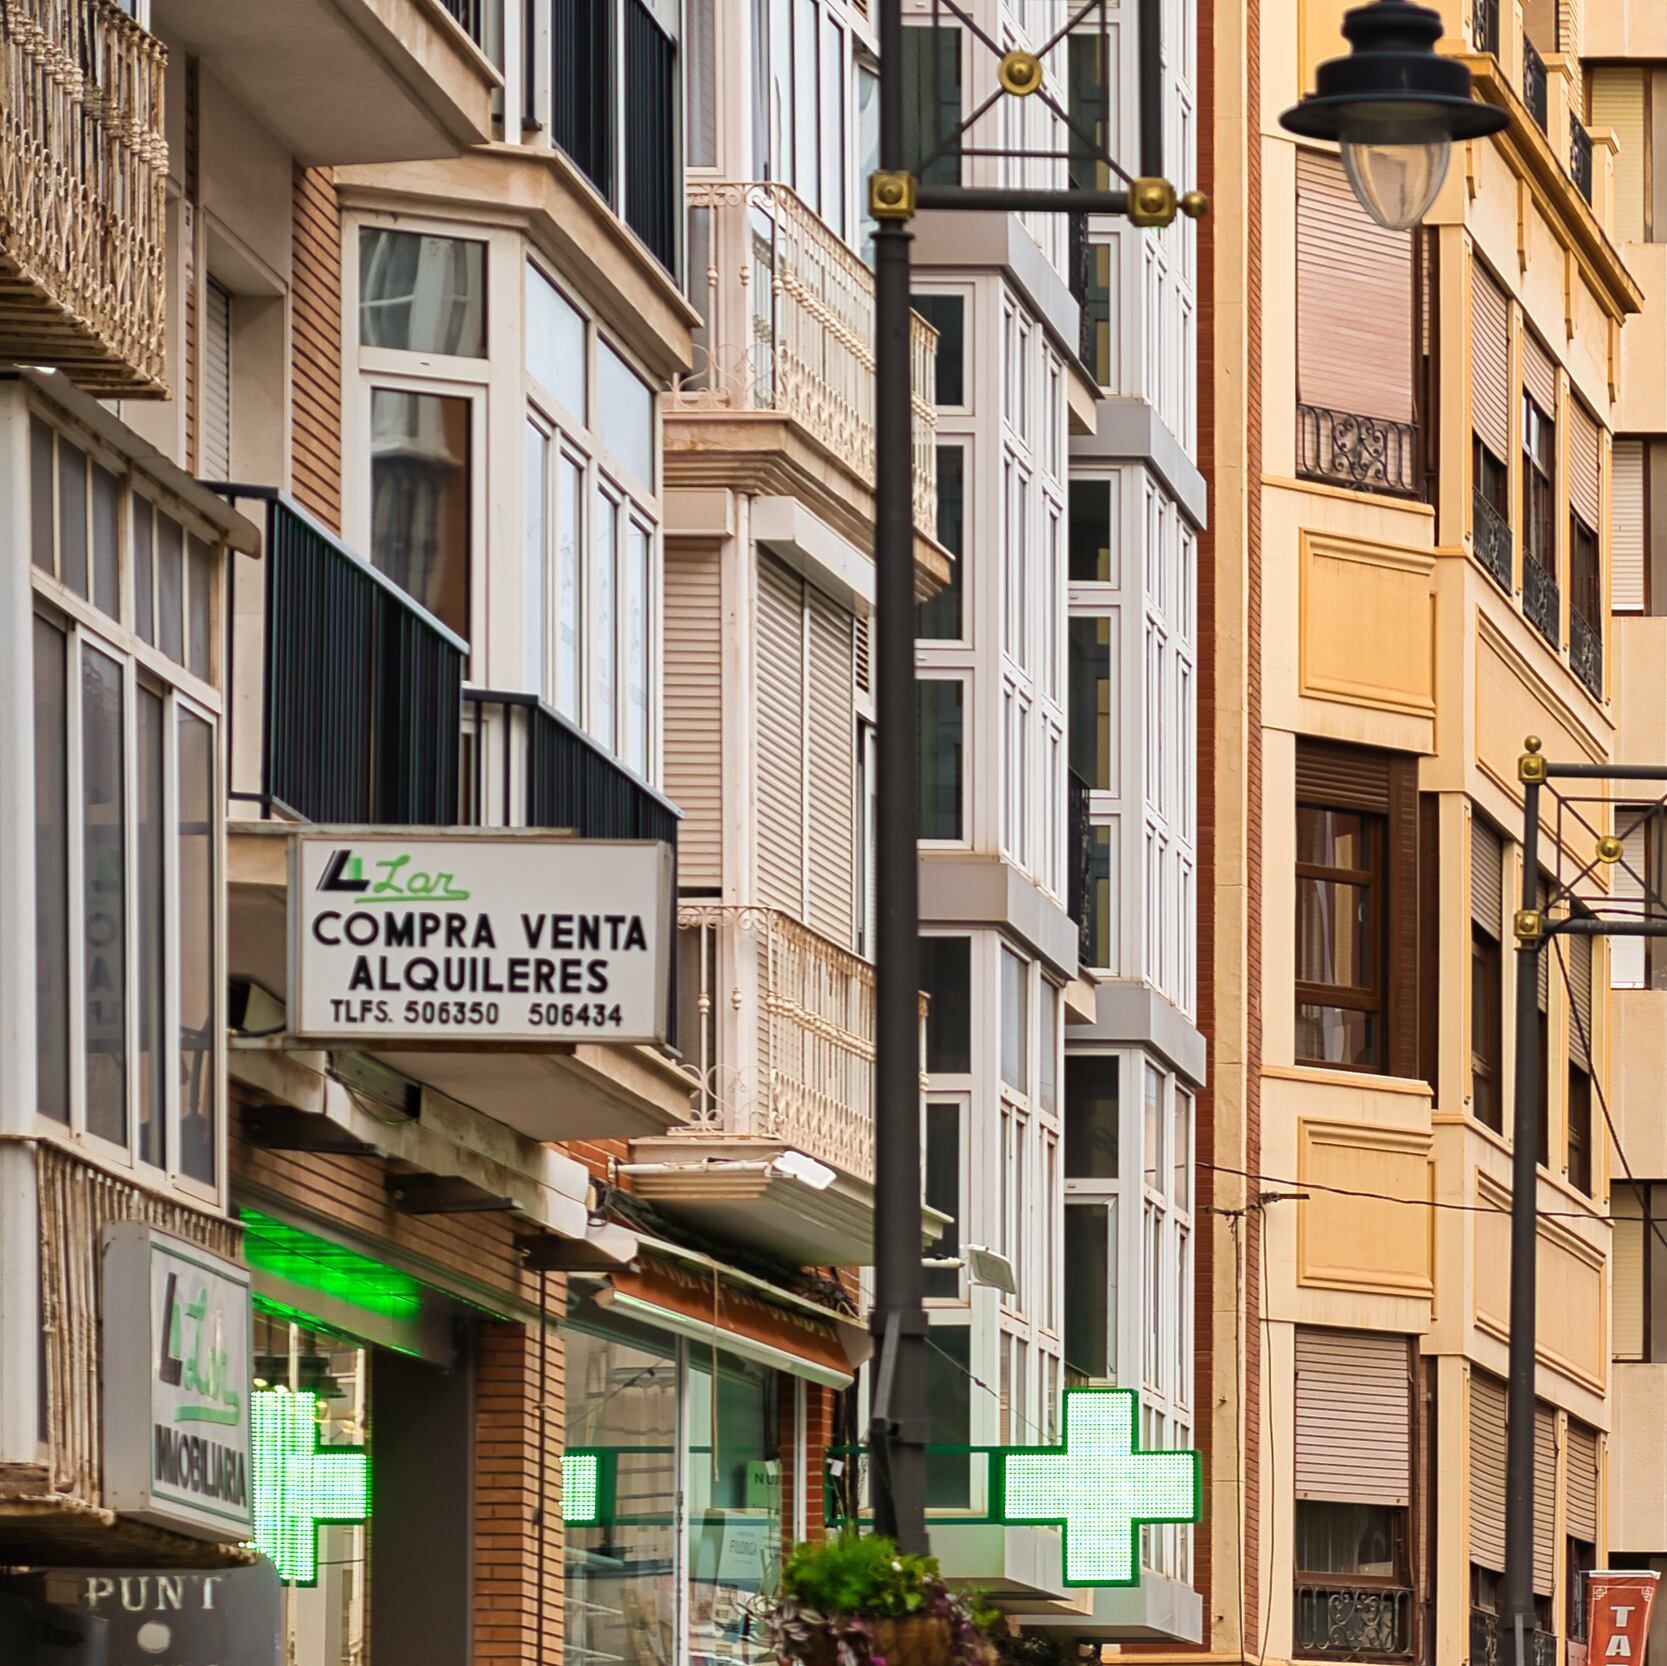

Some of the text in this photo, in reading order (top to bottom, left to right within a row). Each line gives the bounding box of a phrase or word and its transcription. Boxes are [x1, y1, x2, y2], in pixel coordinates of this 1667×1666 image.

[354, 853, 471, 903] Lar
[311, 909, 648, 951] COMPRA VENTA
[348, 955, 610, 994] ALQUILERES
[330, 999, 623, 1027] TLFS. 506350 506434
[84, 1576, 223, 1612] PUNT
